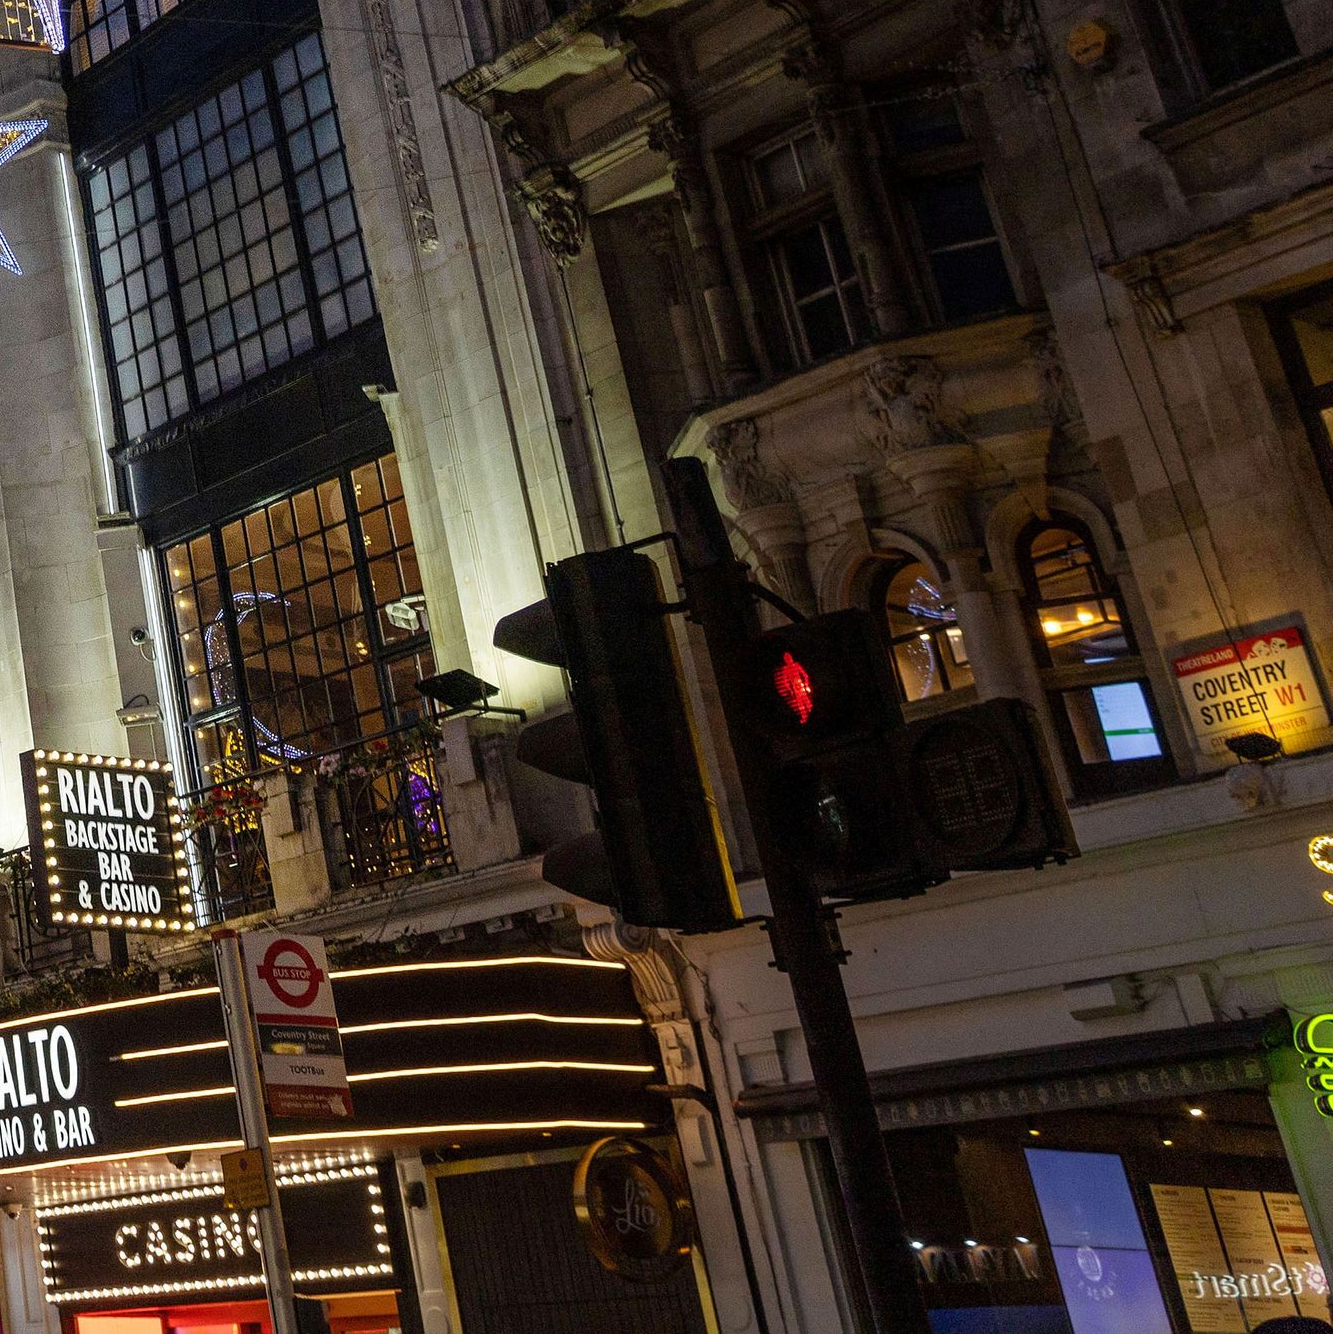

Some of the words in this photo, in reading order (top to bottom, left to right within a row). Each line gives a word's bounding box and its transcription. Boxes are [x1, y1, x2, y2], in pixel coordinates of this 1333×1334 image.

[1178, 648, 1234, 673] THEATRELAND
[1192, 660, 1287, 703] COVENTRY
[1199, 691, 1270, 727] STREET
[1274, 682, 1308, 707] W1
[56, 768, 155, 821] RIALTO
[64, 819, 160, 855] BACKSTAGE
[97, 851, 134, 882] BAR
[78, 879, 94, 910] &
[100, 882, 162, 915] CASINO
[272, 967, 289, 979] BUS
[290, 969, 311, 980] STOP
[271, 1029, 306, 1042] Coventry
[308, 1031, 331, 1042] Street
[33, 1112, 48, 1153] &
[53, 1106, 96, 1150] BAR
